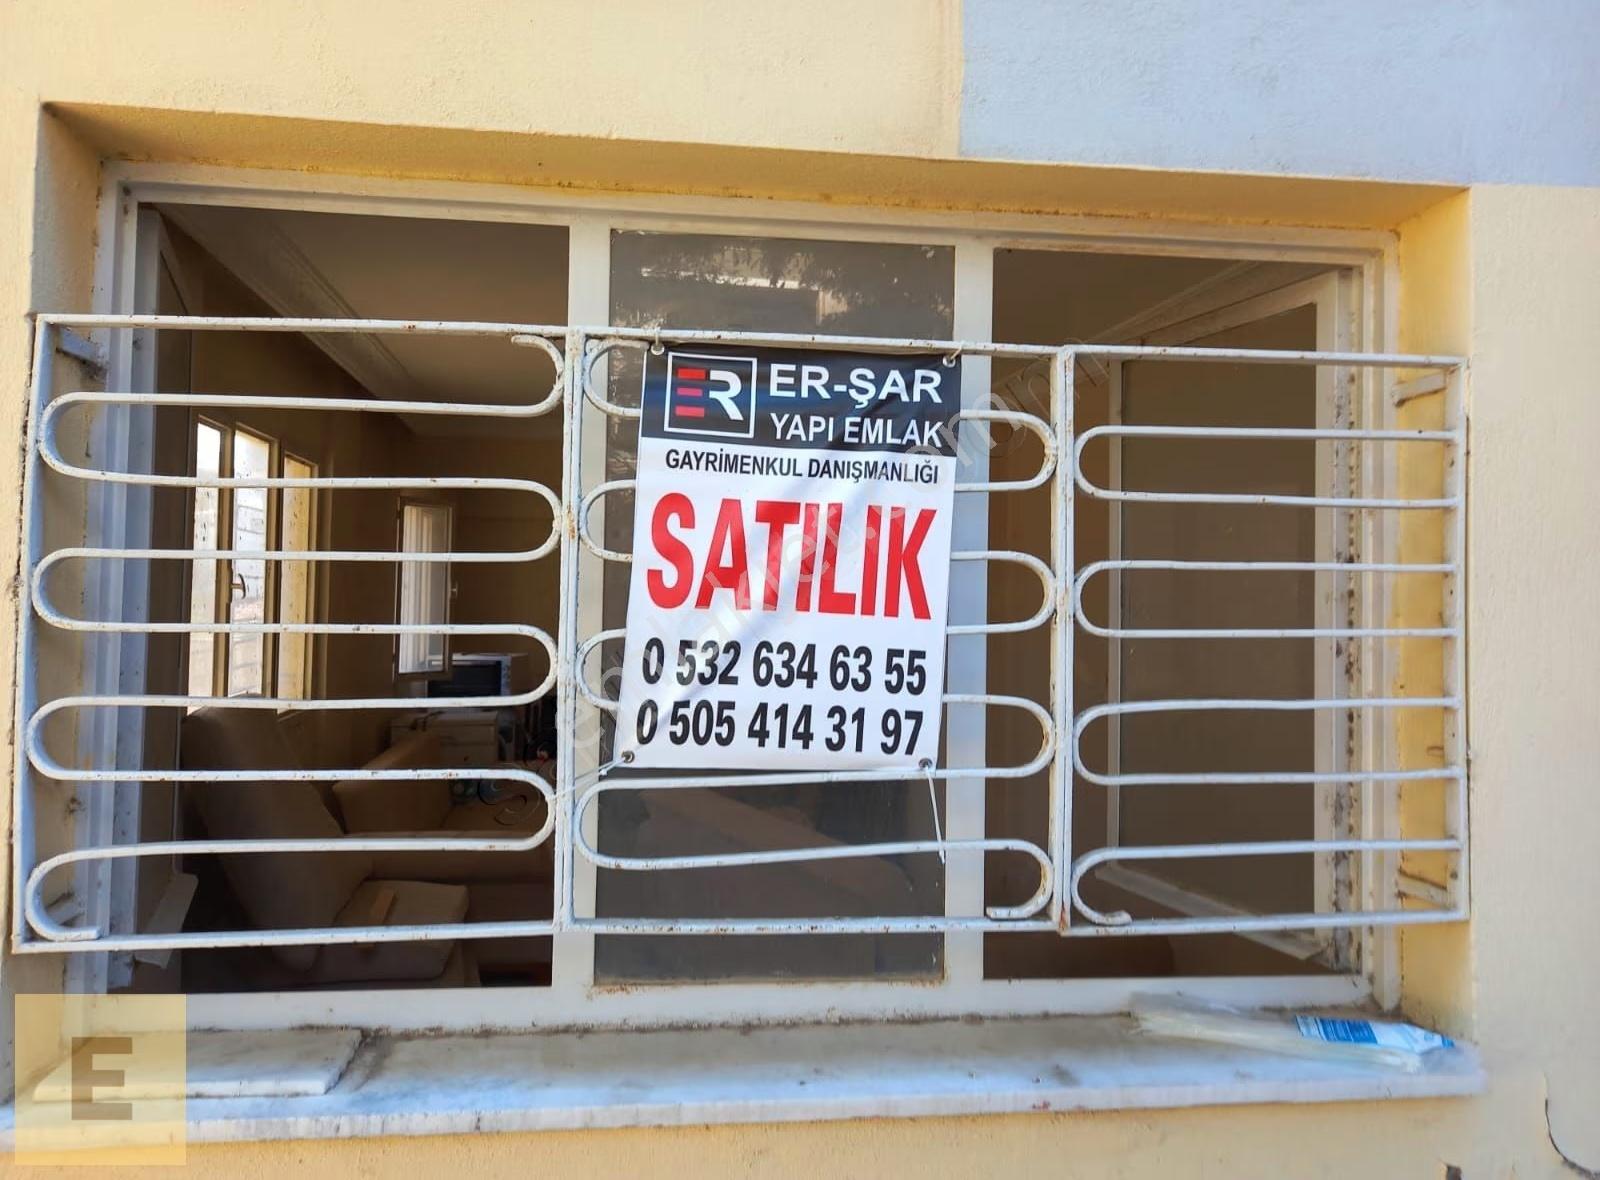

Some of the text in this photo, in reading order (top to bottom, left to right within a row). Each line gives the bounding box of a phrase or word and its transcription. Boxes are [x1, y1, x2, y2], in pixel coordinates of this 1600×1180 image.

[769, 363, 943, 409] ER-ŞAR
[770, 412, 943, 449] YAPI EMLAK
[665, 448, 940, 485] GAYRİMENKUL DANIŞMANLIĞI
[646, 492, 937, 621] SATILIK
[642, 637, 927, 696] 0 532 634 63 55
[636, 699, 924, 756] 0 505 414 31 97
